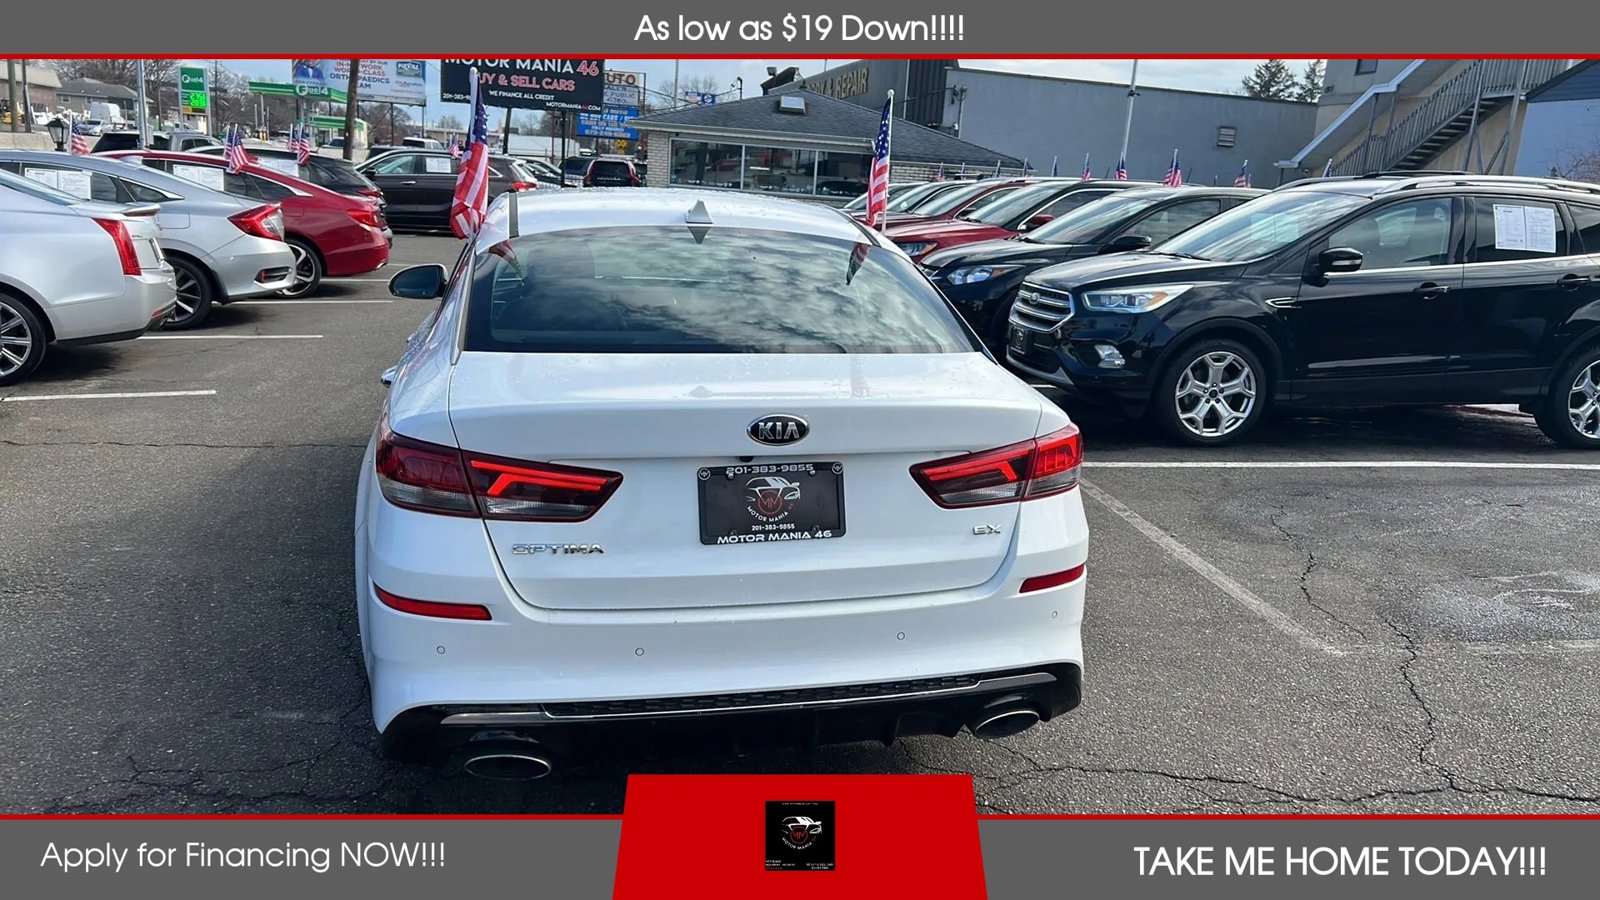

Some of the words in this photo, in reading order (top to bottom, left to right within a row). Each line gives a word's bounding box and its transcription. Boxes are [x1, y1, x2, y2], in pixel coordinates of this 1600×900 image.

[333, 66, 386, 77] WOR-CLASS
[445, 59, 509, 69] OTOR
[516, 59, 574, 74] MANIA
[576, 60, 600, 77] 46
[329, 73, 390, 84] ORTHPAEDICS
[480, 72, 496, 85] UY
[498, 73, 508, 86] &
[510, 75, 540, 89] SELL
[542, 78, 576, 92] CARS
[607, 73, 636, 85] UTO
[836, 67, 869, 99] REPAIR
[499, 91, 523, 99] FINANCE
[758, 421, 800, 439] KIA
[726, 463, 815, 475] 201-383-9855
[746, 506, 768, 523] MOTOR
[768, 511, 789, 523] MANIA
[751, 523, 796, 532] 201-383-9855
[972, 524, 1002, 536] EX
[716, 533, 766, 545] MOTOR
[768, 531, 812, 542] MANIA
[814, 530, 833, 539] 46
[512, 543, 605, 555] OPTIMA
